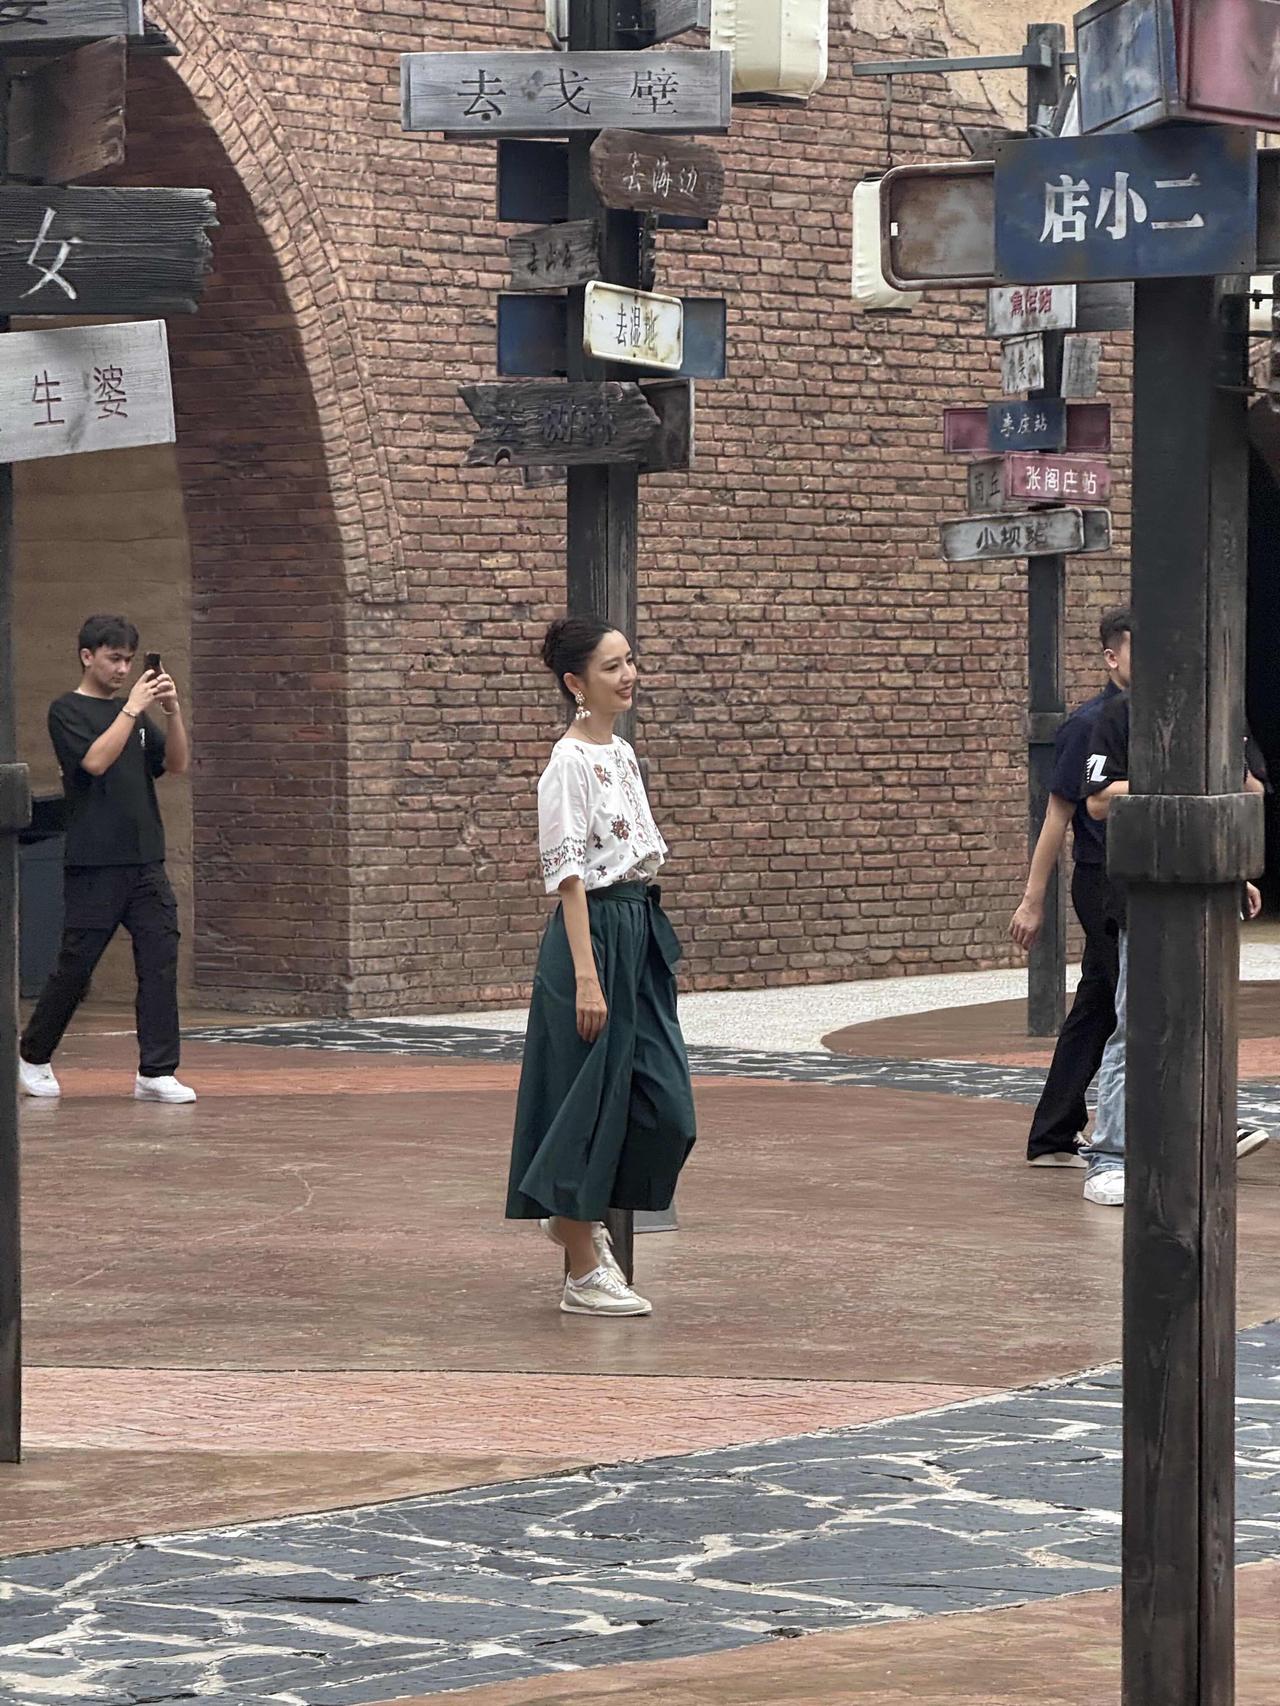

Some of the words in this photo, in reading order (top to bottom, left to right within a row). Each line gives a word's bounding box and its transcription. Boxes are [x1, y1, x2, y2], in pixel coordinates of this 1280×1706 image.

[457, 67, 680, 121] 去戈壁
[1038, 171, 1206, 243] 店小二
[15, 207, 83, 300] 女
[1025, 466, 1097, 495] 张阁庄站
